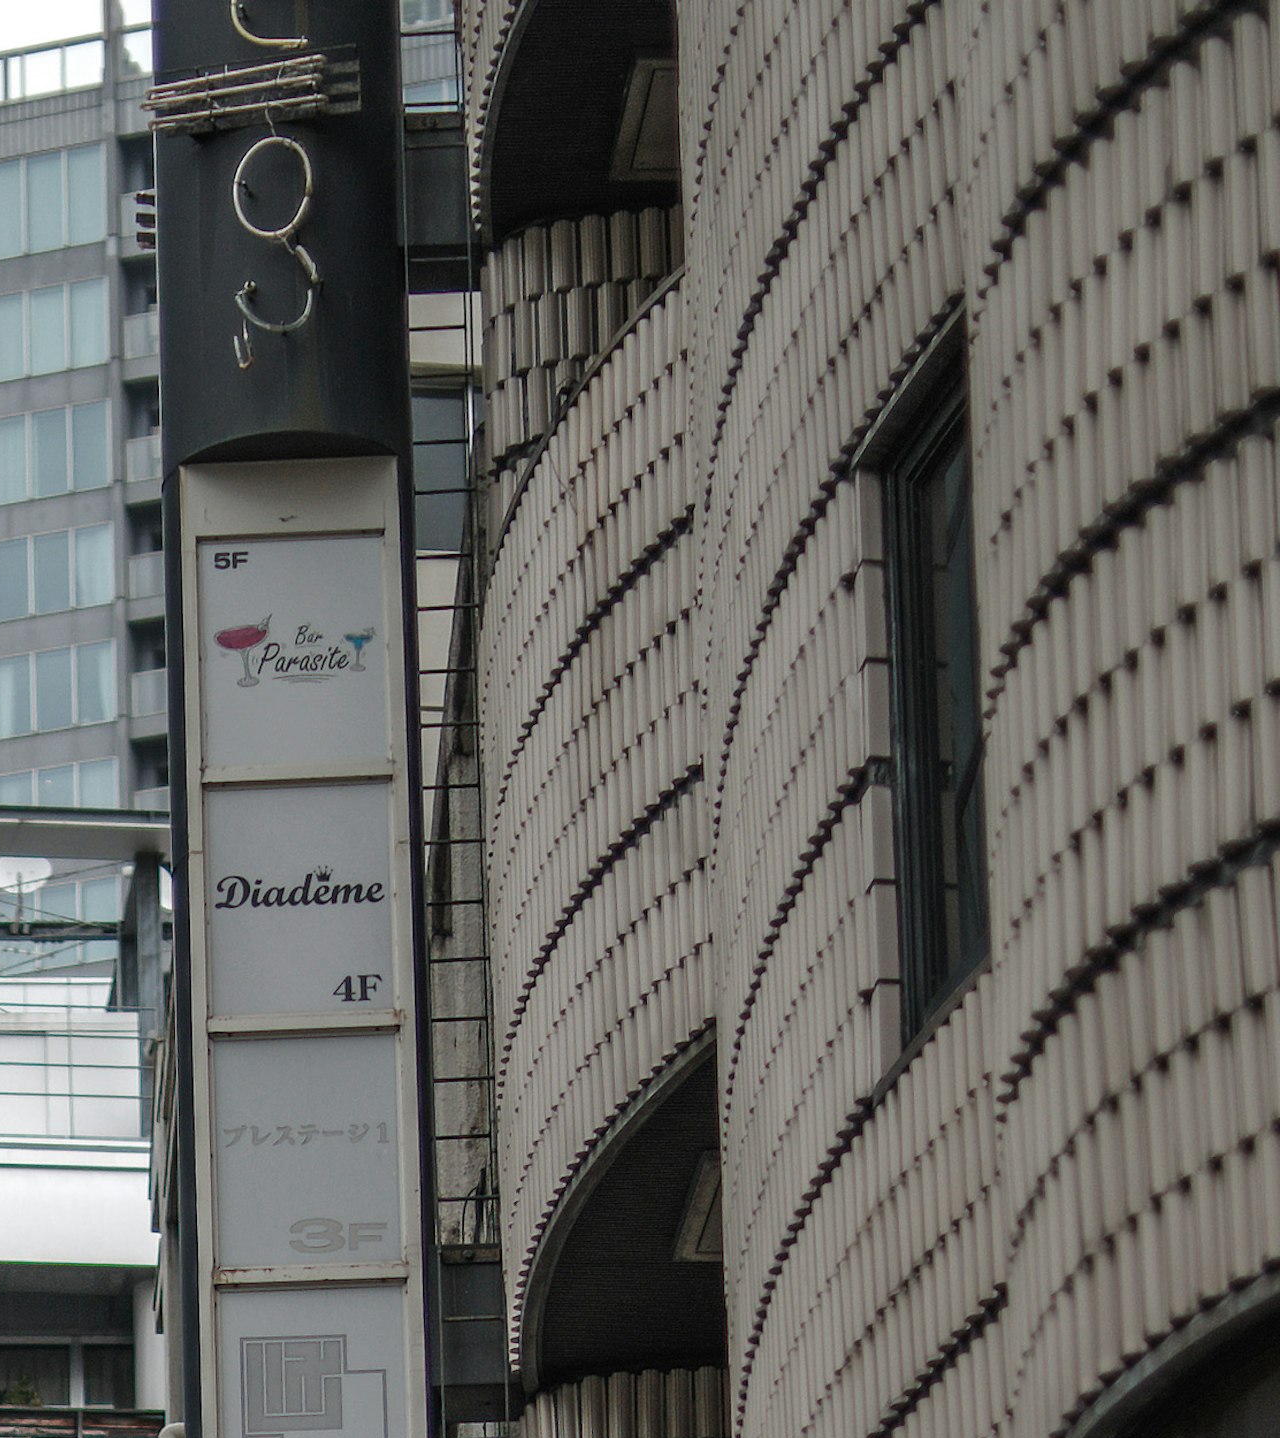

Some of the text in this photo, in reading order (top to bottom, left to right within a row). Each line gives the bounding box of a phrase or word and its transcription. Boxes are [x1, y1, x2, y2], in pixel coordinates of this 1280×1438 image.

[213, 551, 249, 570] 5F
[295, 624, 323, 646] Bar
[257, 643, 350, 676] Parasite
[333, 975, 383, 1002] 4F
[223, 1122, 391, 1148] プレステージ1
[289, 1218, 387, 1253] 3F
